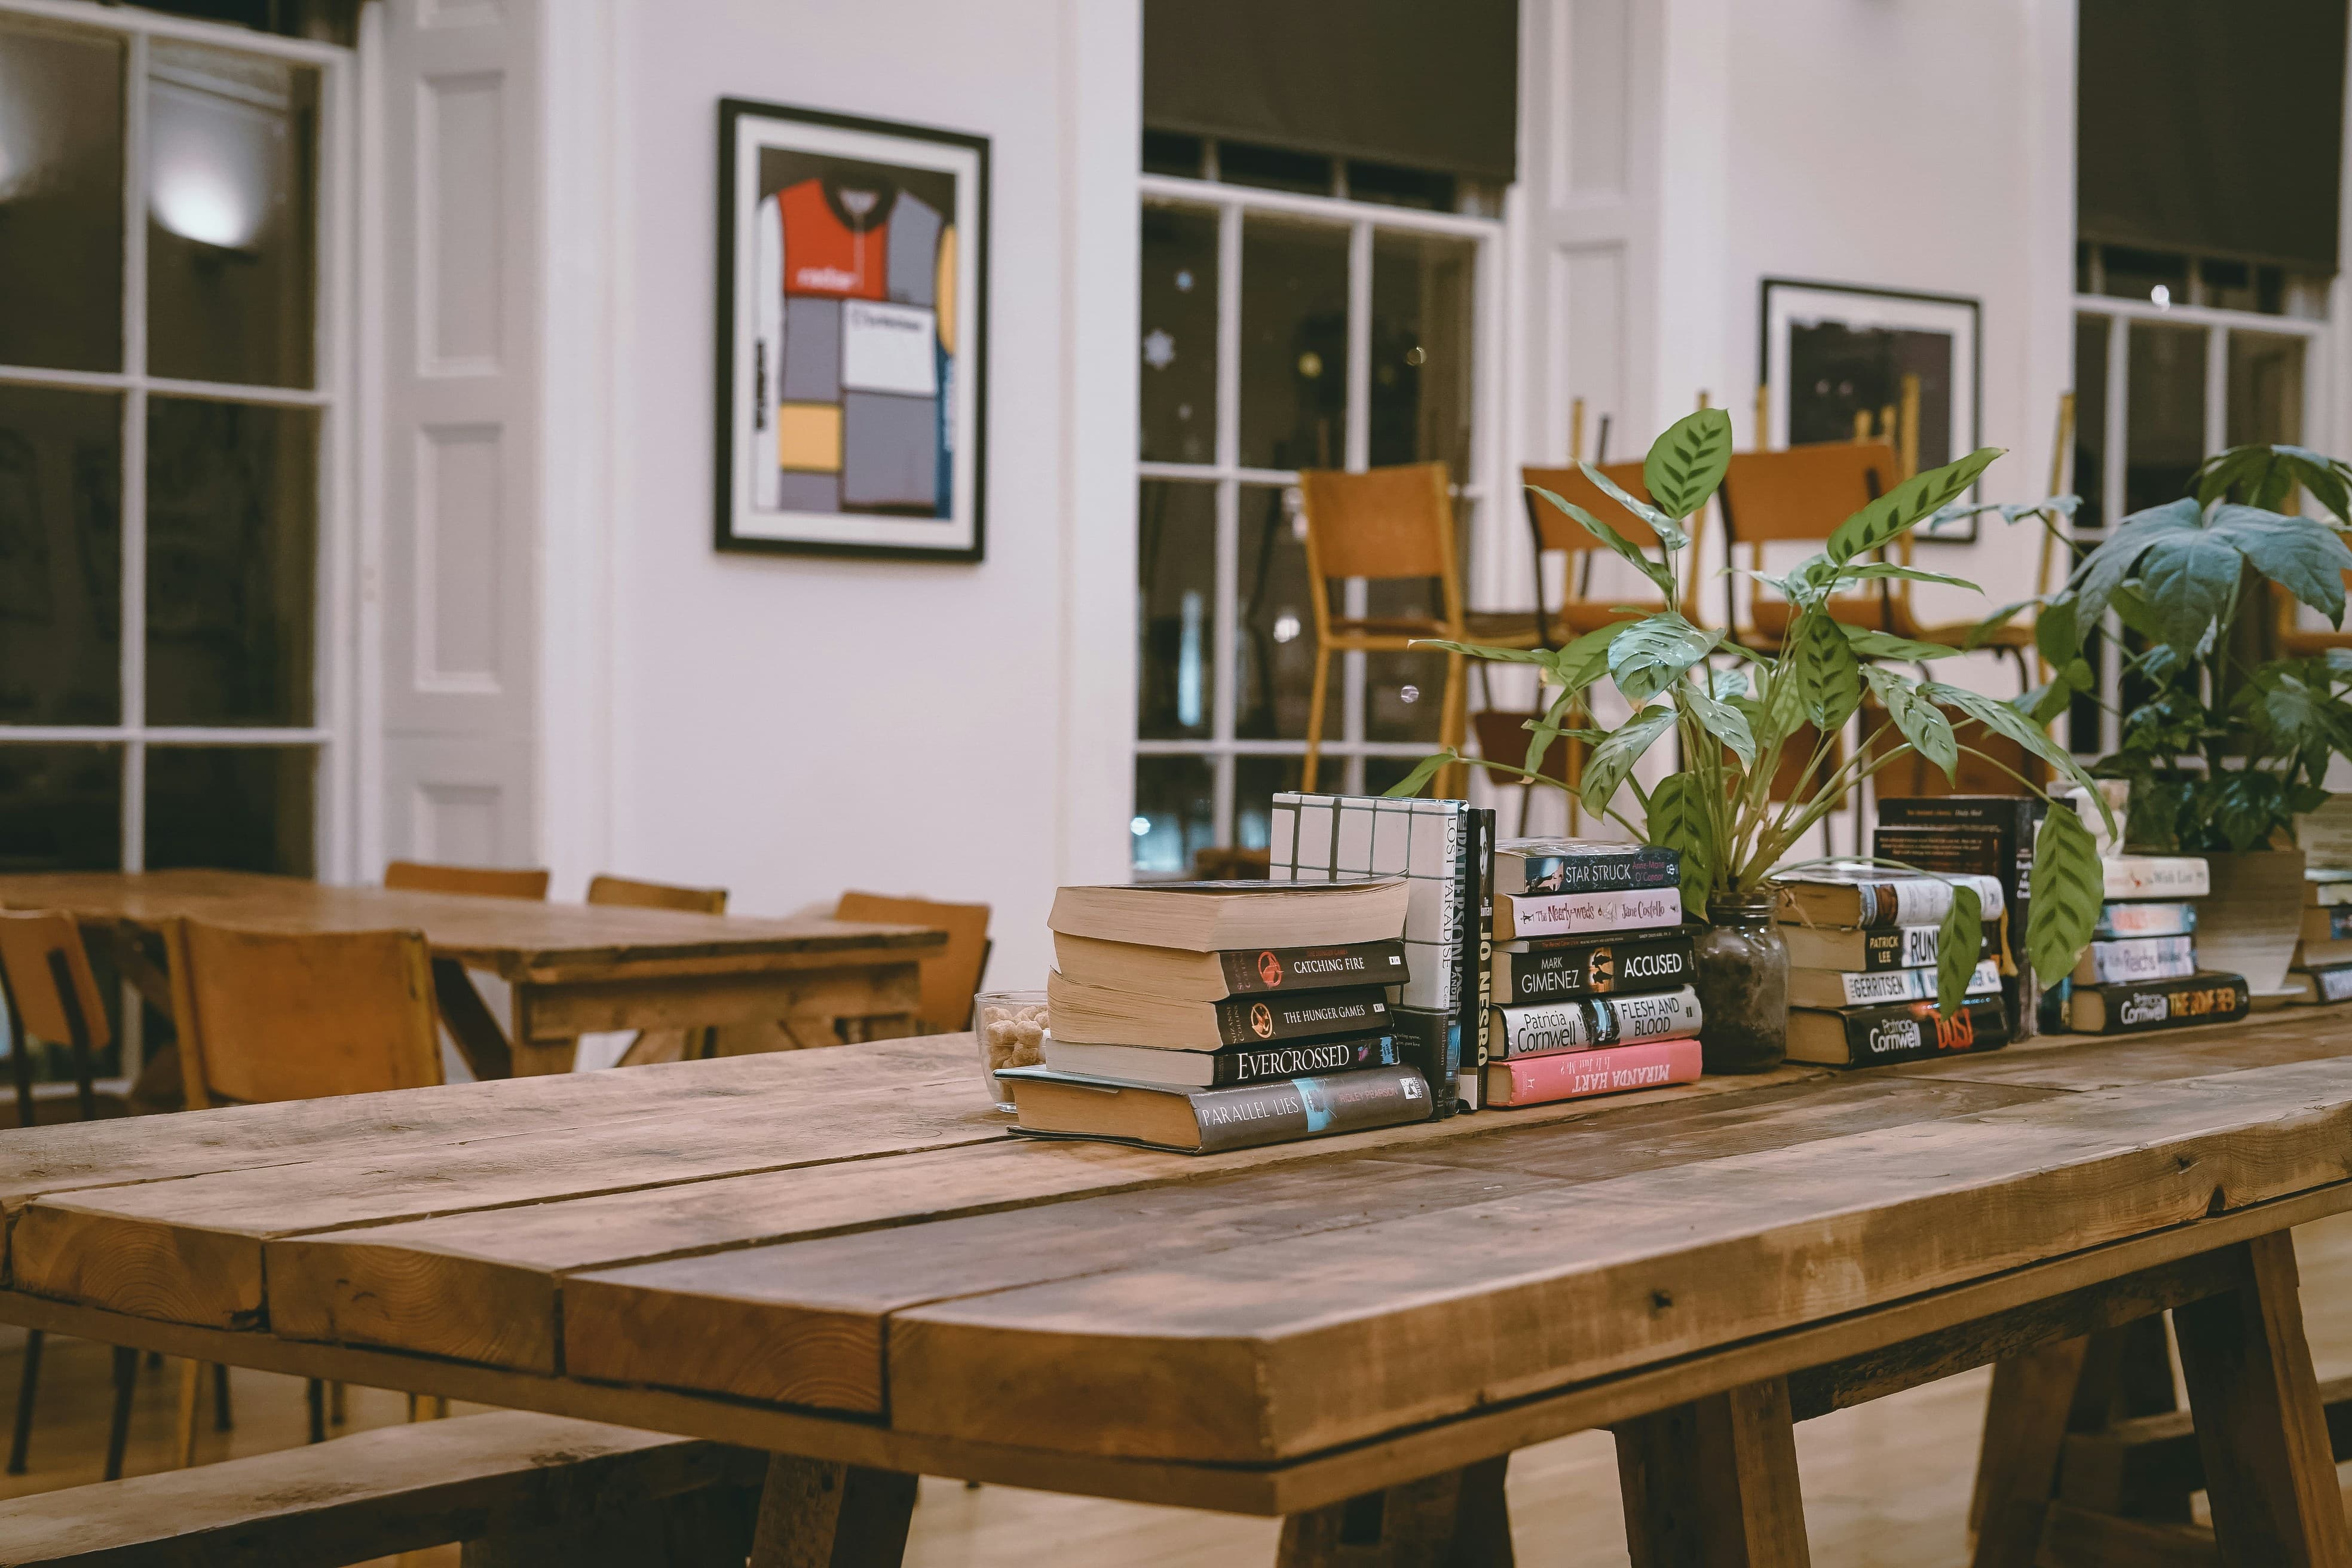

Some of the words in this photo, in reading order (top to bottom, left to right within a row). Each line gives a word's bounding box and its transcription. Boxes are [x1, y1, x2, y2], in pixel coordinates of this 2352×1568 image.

[1446, 817, 1456, 863] LOST
[1566, 868, 1590, 883] STAR
[1593, 864, 1631, 881] STRUCK
[1536, 911, 1547, 921] The
[1548, 902, 1594, 929] Nearly-weds
[1622, 904, 1637, 919] Jane
[1637, 901, 1665, 919] Costello
[1443, 875, 1454, 969] PARADISE
[1480, 922, 1491, 961] JO
[1869, 936, 1898, 949] PATRICK
[1294, 958, 1343, 973] CATCHING
[1345, 957, 1365, 970] FIRE
[1541, 956, 1563, 970] MARK
[1624, 953, 1682, 978] ACCUSED
[1879, 951, 1891, 963] LEE
[1522, 970, 1580, 993] GIMENEZ
[1854, 974, 1905, 997] GERRITSEN
[1284, 1012, 1300, 1024] THE
[1303, 1008, 1337, 1022] HUNGER
[1339, 1004, 1365, 1018] GAMES
[1621, 1000, 1656, 1019] FLESH
[1659, 997, 1679, 1013] AND
[1524, 1010, 1566, 1030] Patricia
[1634, 1016, 1670, 1036] BLOOD
[1518, 1021, 1576, 1053] Cornwell
[1870, 1022, 1921, 1053] Cornwell
[1579, 1058, 1593, 1071] Just
[1612, 1064, 1671, 1087] MIRANDA
[1413, 1077, 1423, 1098] ORION
[1572, 1071, 1608, 1094] HART
[1338, 1091, 1363, 1102] RIDLEY
[1365, 1087, 1398, 1100] PEARSON
[1202, 1101, 1270, 1126] PARALLEL
[1271, 1097, 1299, 1116] LIES
